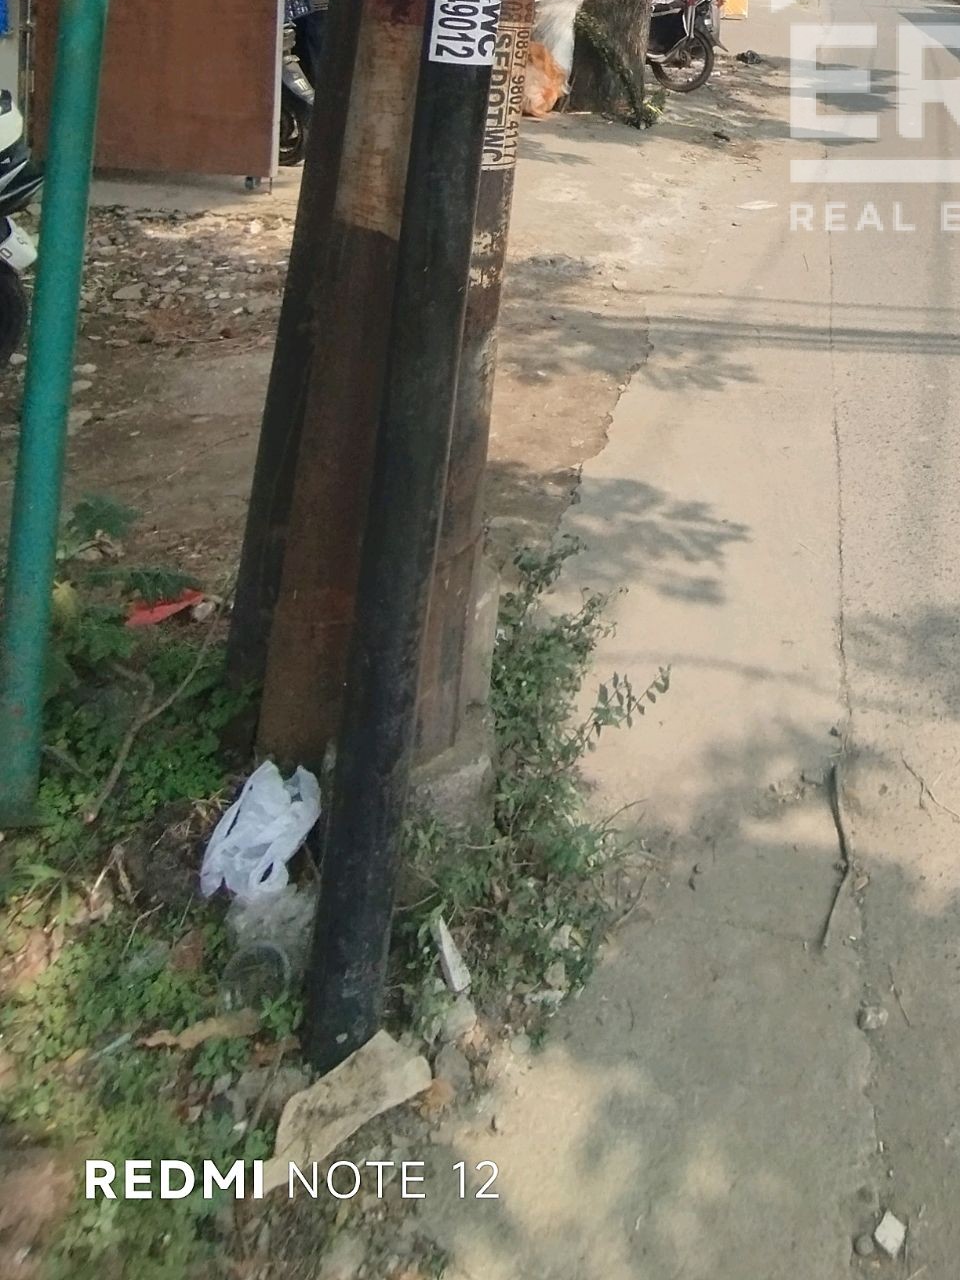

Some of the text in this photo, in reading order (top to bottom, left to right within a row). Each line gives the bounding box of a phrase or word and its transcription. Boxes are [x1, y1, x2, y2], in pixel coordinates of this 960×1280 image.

[478, 1, 501, 58] WC
[513, 29, 530, 69] 0857
[508, 74, 525, 116] 9802
